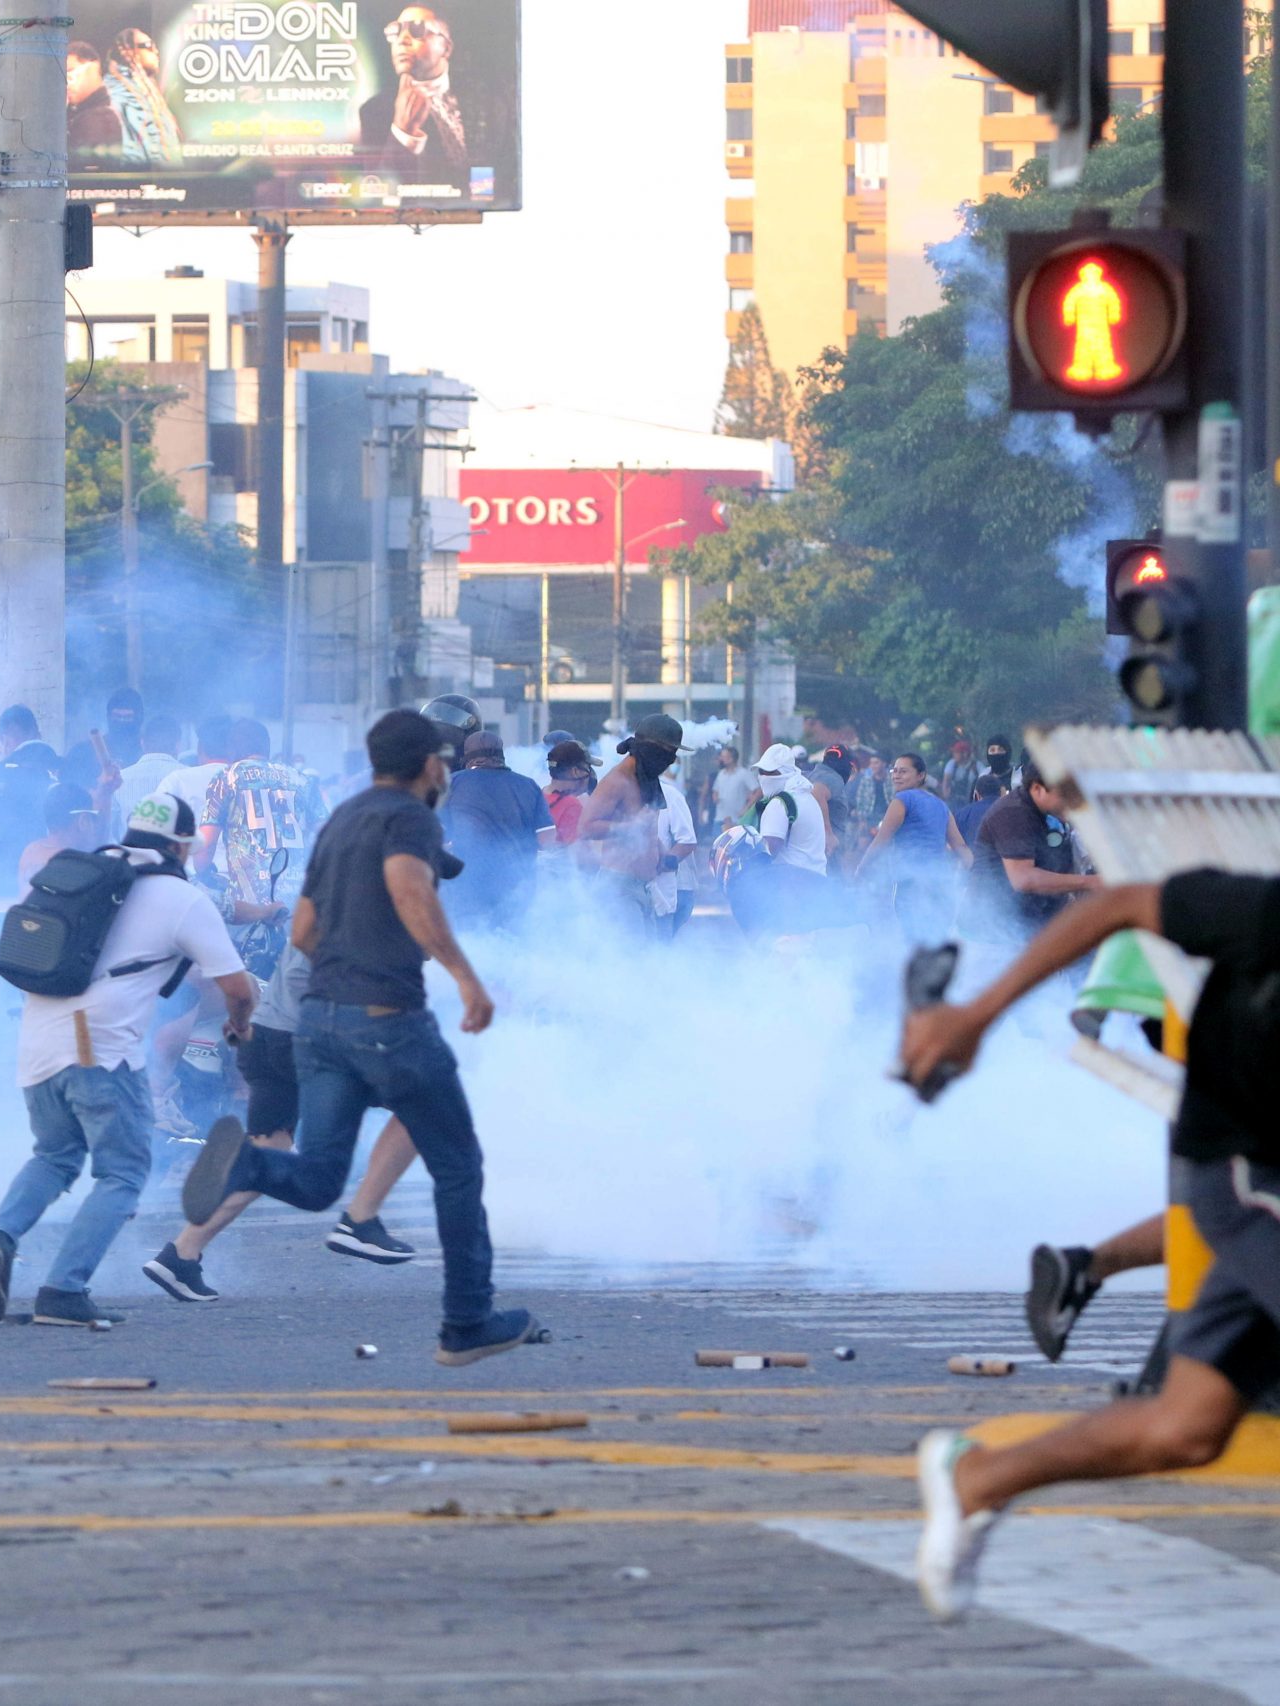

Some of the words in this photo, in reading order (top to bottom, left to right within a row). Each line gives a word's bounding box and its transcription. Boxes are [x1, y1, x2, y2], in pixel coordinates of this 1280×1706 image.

[193, 4, 234, 21] THE
[234, 2, 357, 41] DON
[184, 23, 234, 41] KING
[178, 43, 357, 84] OMAR
[184, 88, 235, 103] ZION
[266, 88, 350, 101] LENNOX
[182, 143, 236, 157] ESTADIO
[239, 143, 270, 157] REAL
[273, 143, 316, 157] SANTA
[317, 143, 354, 156] CRUZ
[462, 496, 598, 525] OTORS
